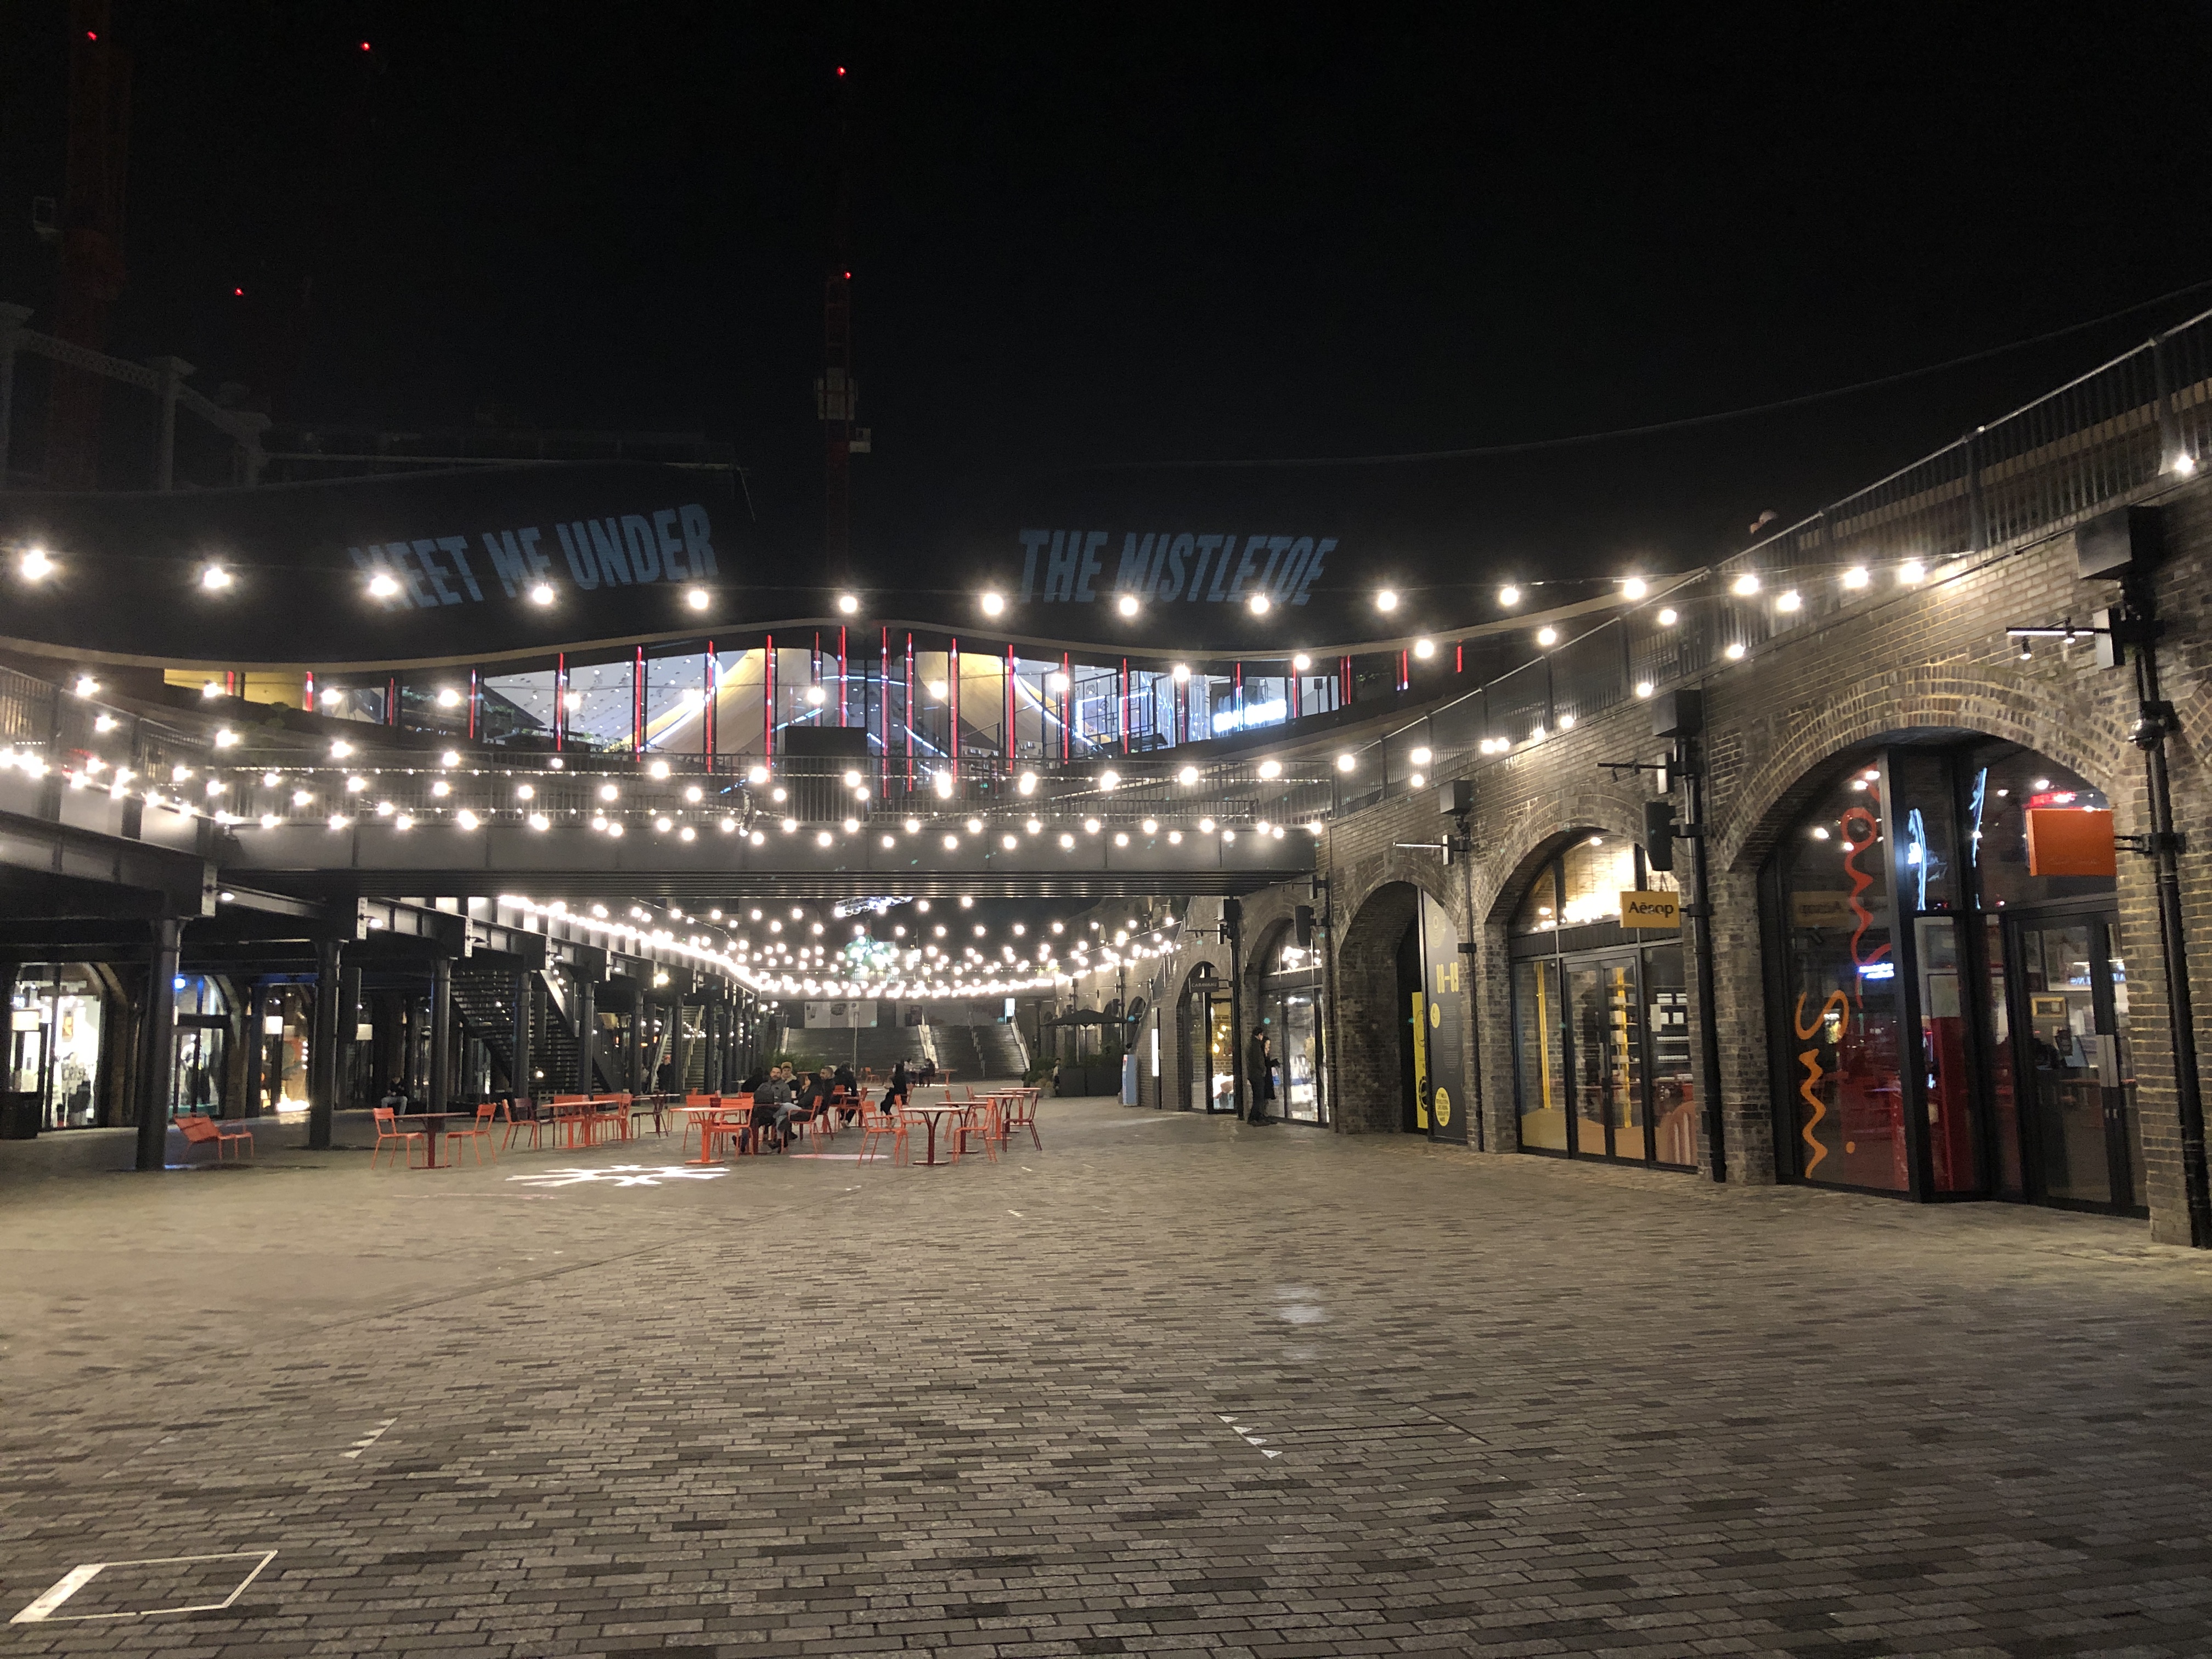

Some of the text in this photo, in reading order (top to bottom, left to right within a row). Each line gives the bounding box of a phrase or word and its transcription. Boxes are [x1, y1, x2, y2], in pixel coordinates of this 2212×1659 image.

[348, 504, 719, 610] MEET ME UNDER
[1019, 529, 1339, 606] THE MISTLETOE
